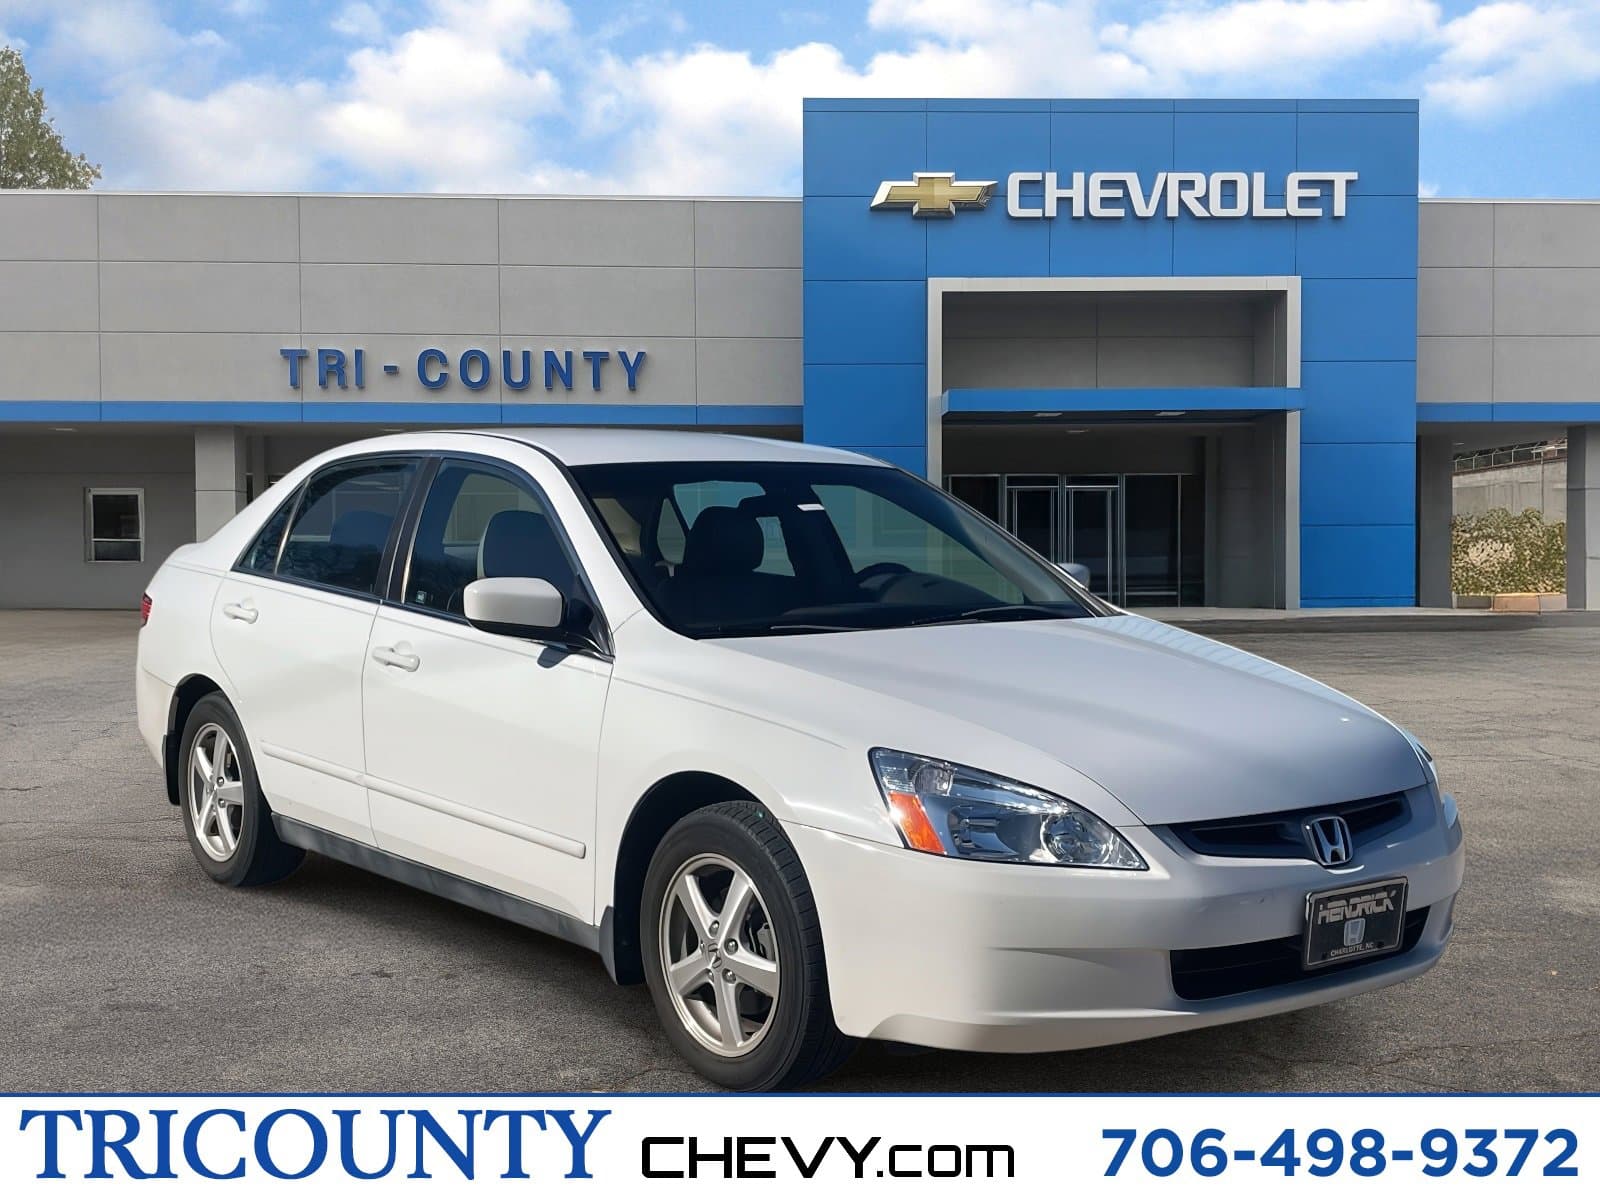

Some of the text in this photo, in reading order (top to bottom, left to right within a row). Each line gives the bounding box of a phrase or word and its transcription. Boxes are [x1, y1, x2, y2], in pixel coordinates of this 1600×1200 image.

[1007, 171, 1358, 218] CHEVROLET
[280, 348, 366, 390] TRI
[416, 347, 647, 392] COUNTY
[1317, 889, 1397, 925] HENDRICK
